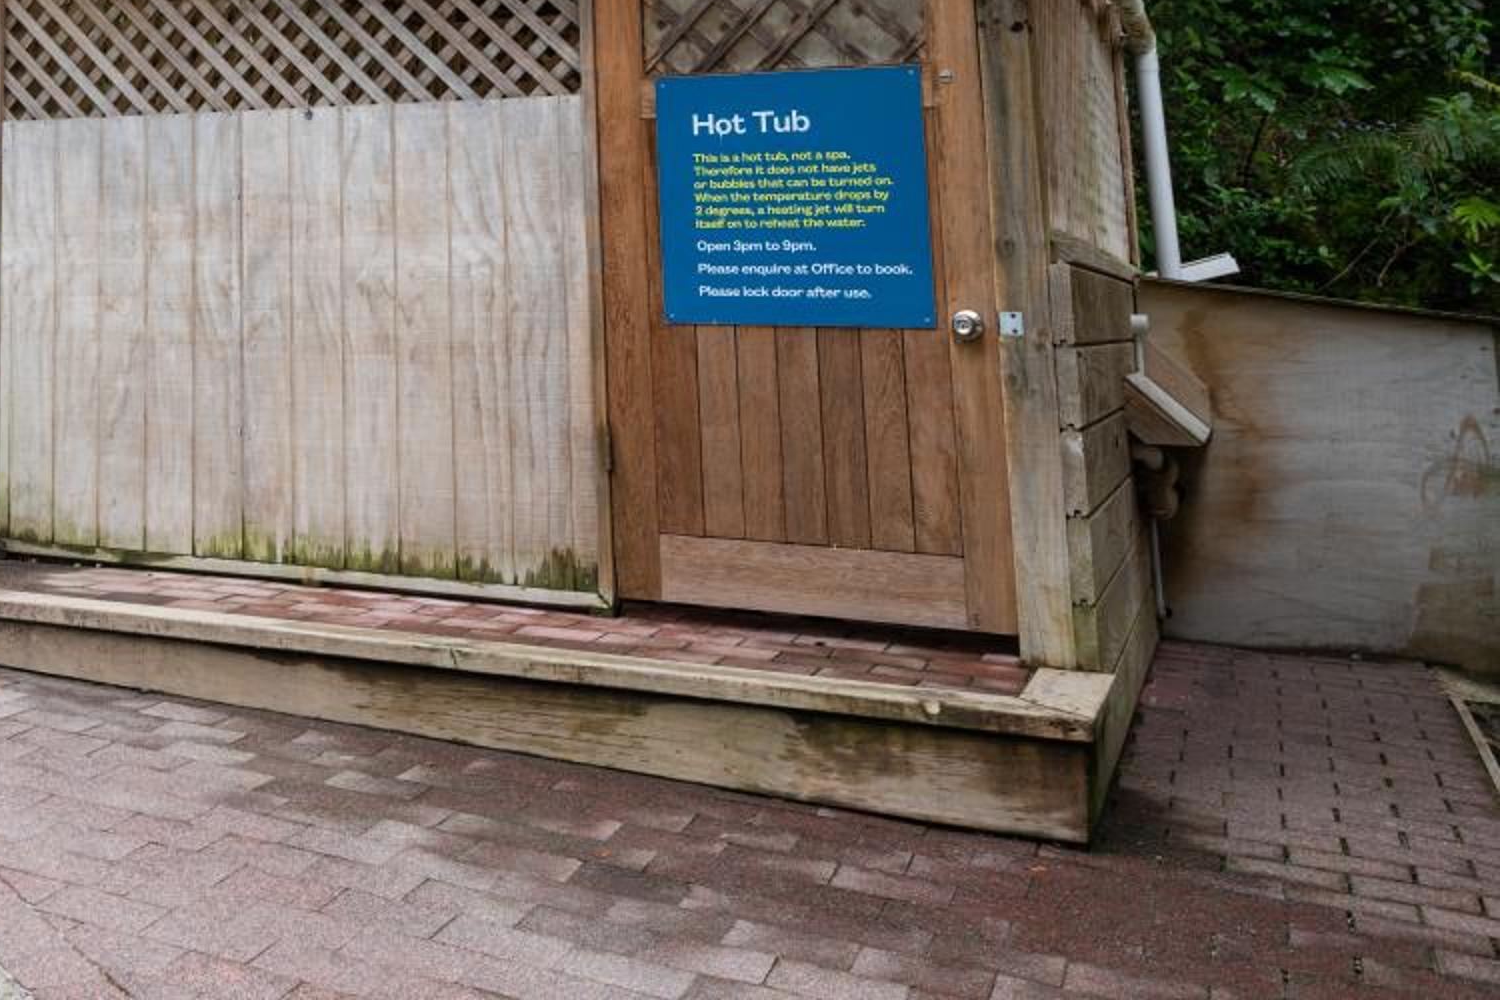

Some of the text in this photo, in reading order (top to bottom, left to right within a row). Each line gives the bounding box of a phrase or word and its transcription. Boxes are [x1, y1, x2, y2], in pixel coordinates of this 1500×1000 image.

[691, 109, 811, 136] Hot Tub
[692, 151, 851, 163] This is a hot tub, not a spa.
[694, 162, 877, 176] Therefore it does not have jets
[693, 176, 894, 189] or bubbles that can be turned on.
[694, 188, 889, 203] When the temperature drops by
[695, 203, 885, 217] 2 degrees, a heating jet will turn
[695, 217, 867, 229] itself on to reheat the water.
[697, 239, 817, 253] Open 3pm to 9pm.
[698, 263, 913, 276] Please enquire at Office to book.
[699, 285, 872, 299] Please lock door after use.
